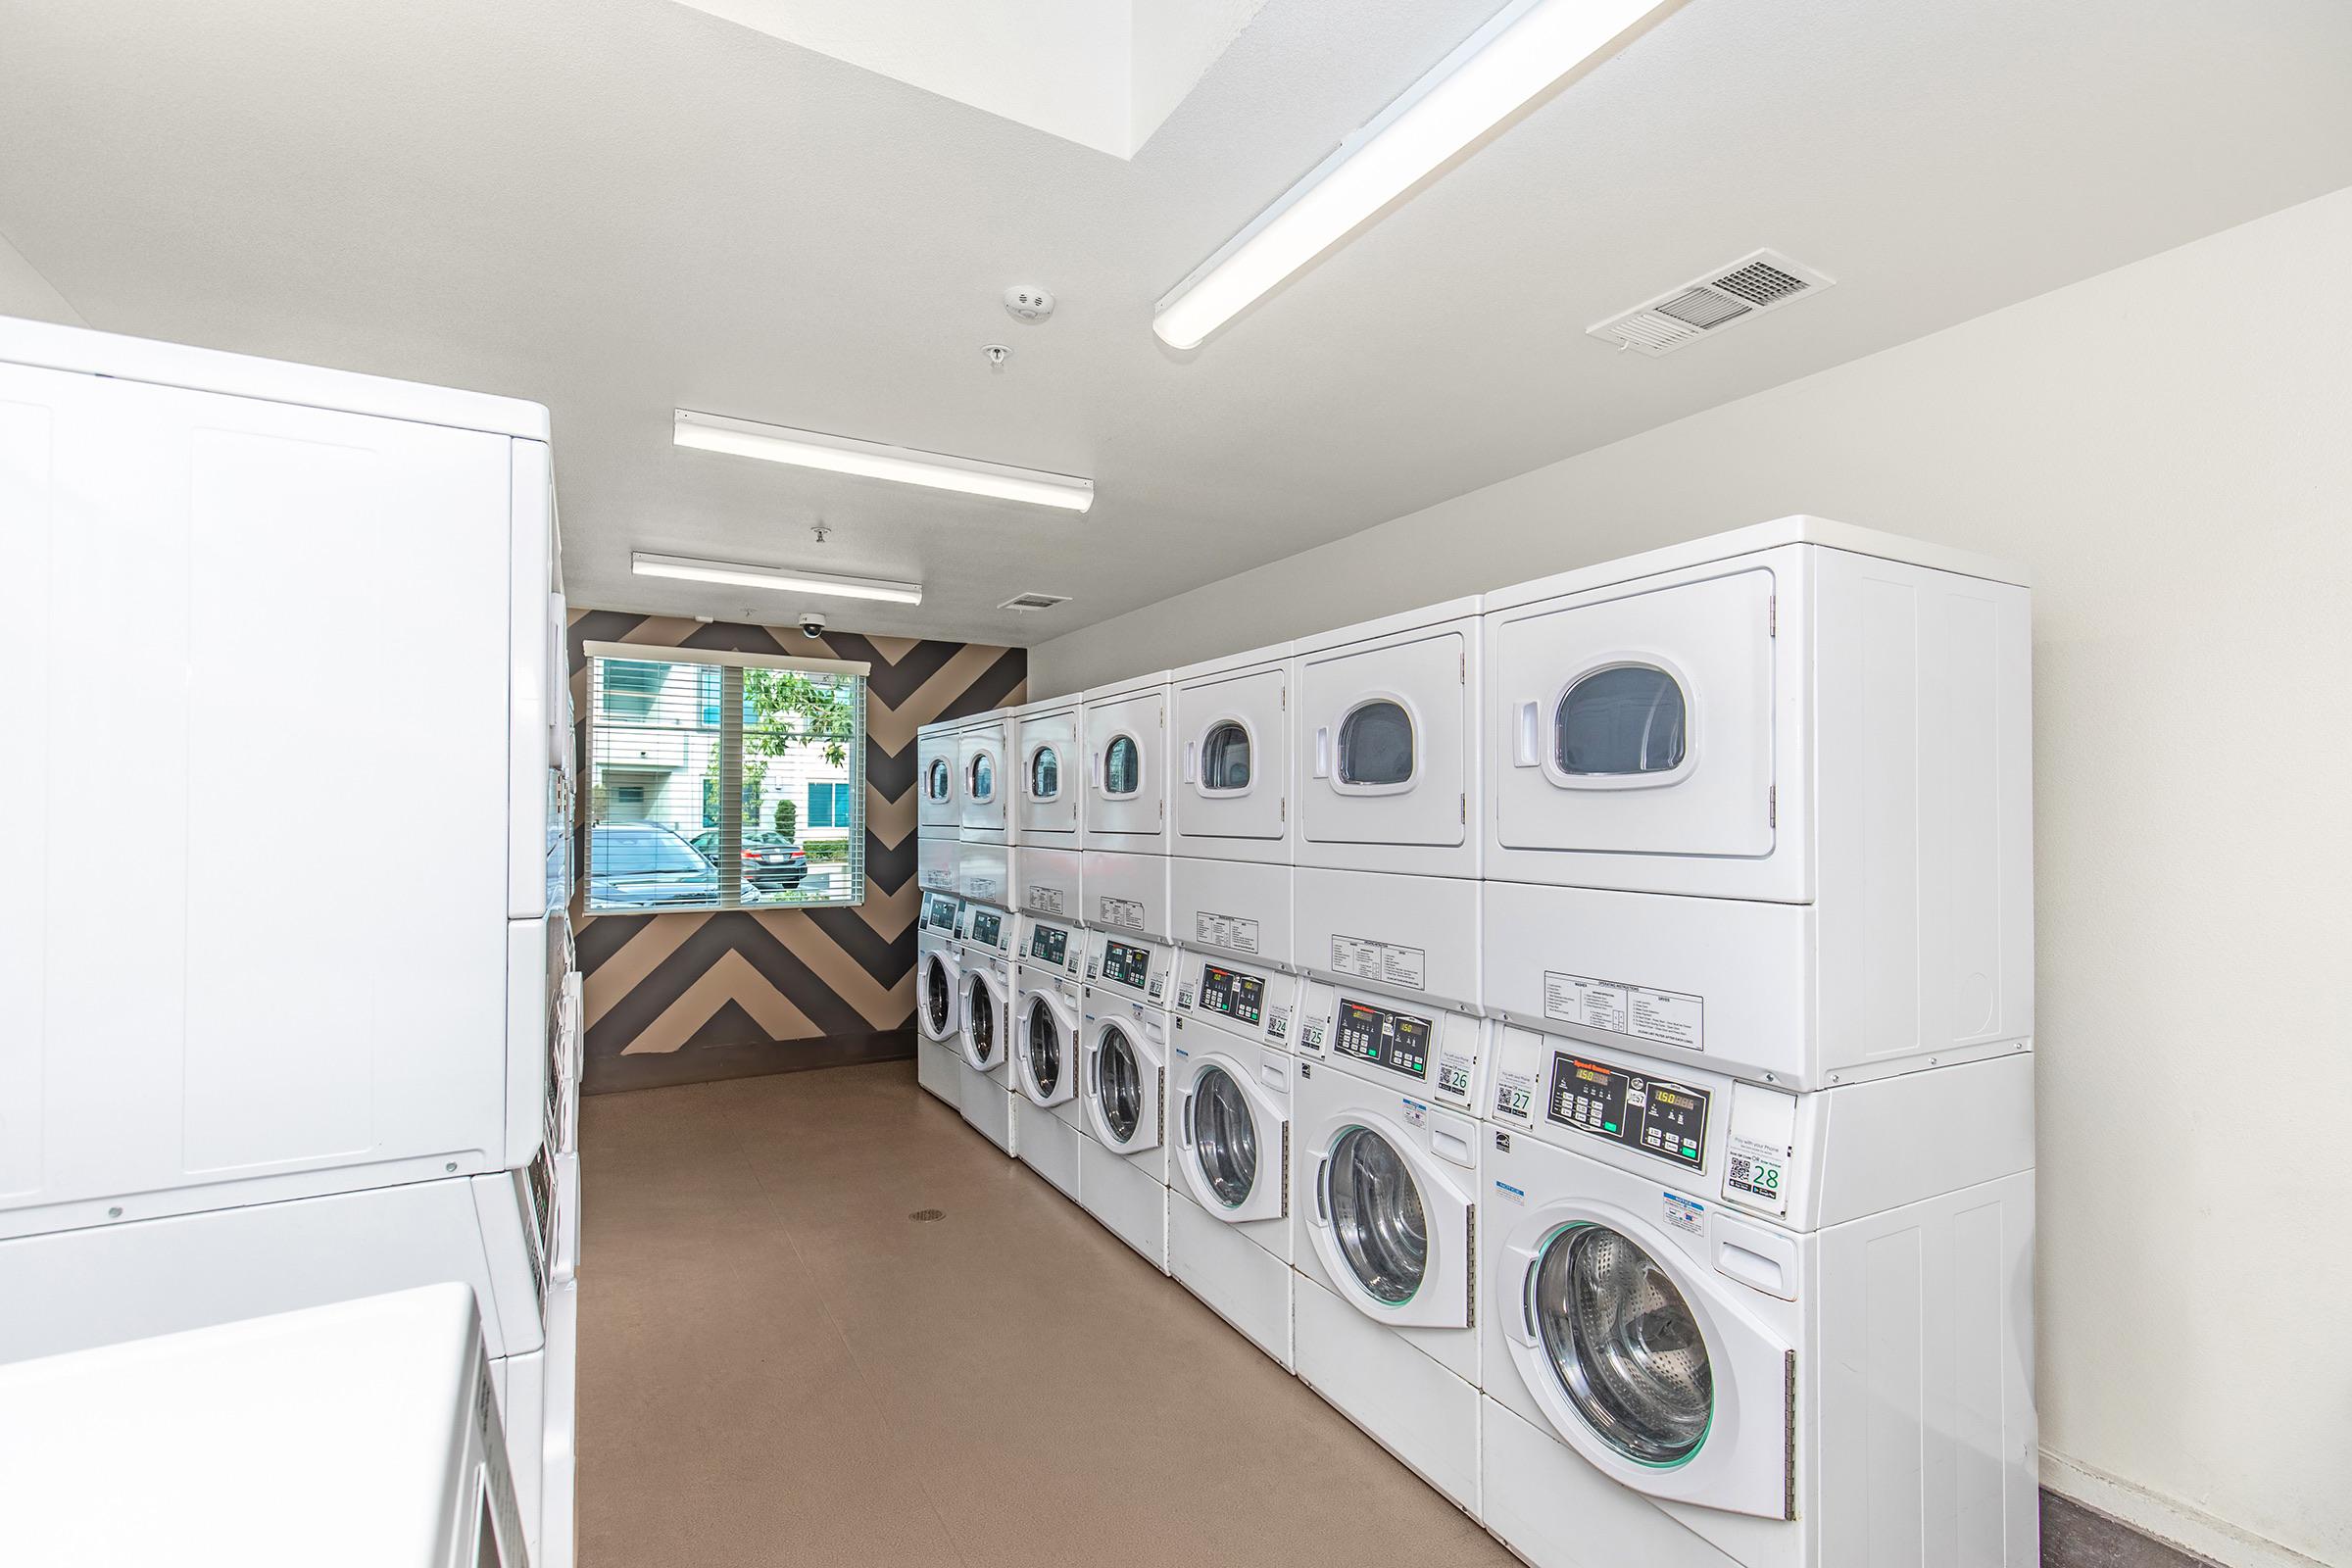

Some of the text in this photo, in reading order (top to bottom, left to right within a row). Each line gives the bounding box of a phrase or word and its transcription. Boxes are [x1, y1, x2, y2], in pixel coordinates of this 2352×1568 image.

[1184, 994, 1192, 1004] 23
[1276, 1020, 1287, 1032] 24
[1310, 1031, 1322, 1045] 25
[1452, 1072, 1467, 1088] 26
[1513, 1093, 1530, 1109] 27
[1753, 1165, 1779, 1189] 28
